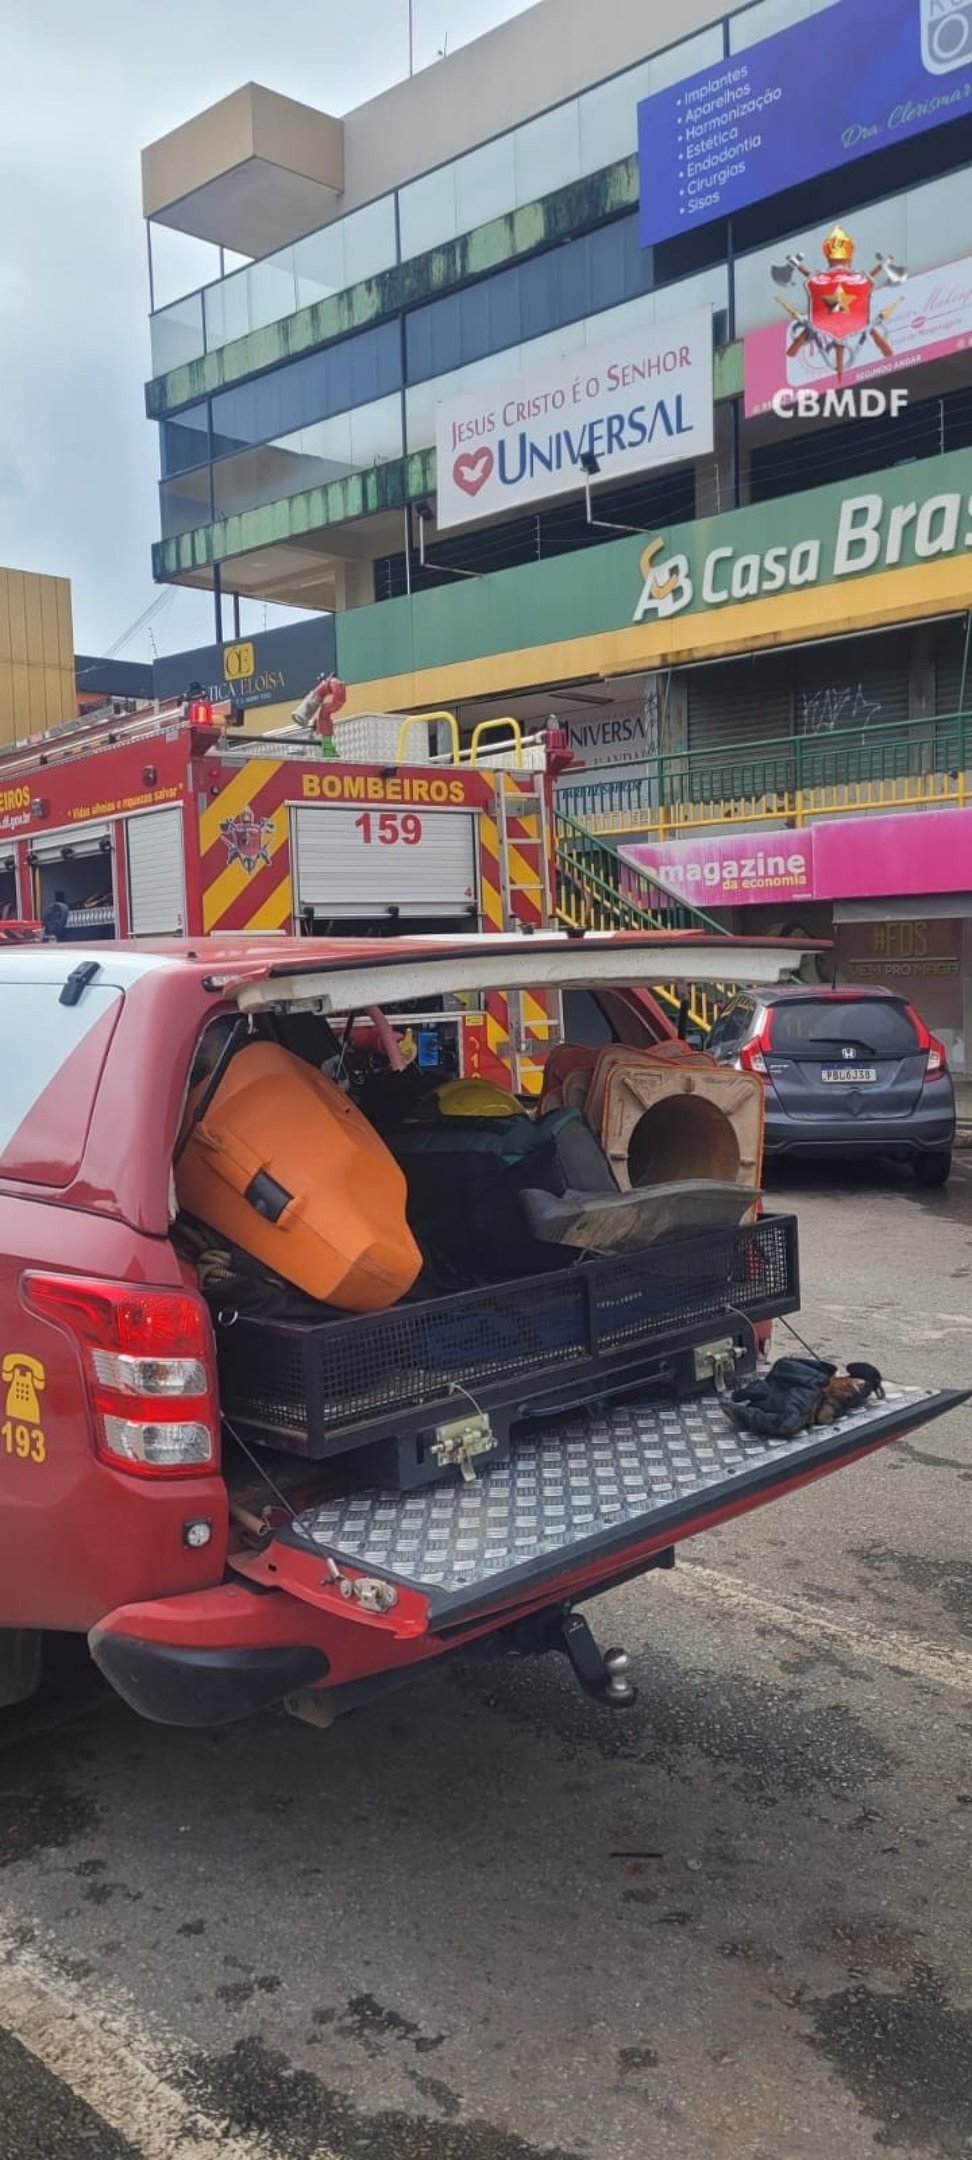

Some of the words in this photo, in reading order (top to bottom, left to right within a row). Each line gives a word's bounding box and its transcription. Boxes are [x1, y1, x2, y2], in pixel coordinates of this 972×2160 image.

[685, 65, 748, 105] Implantes
[685, 83, 751, 124] Aparelhos
[685, 87, 783, 141] Harmonização
[686, 126, 739, 159] Estética
[687, 134, 762, 178] Endodontia
[687, 161, 747, 196] Cirurgias
[687, 191, 721, 214] Sisos
[451, 413, 495, 451] JESUS
[502, 387, 565, 428] CRISTO
[572, 376, 584, 405] É
[585, 379, 600, 399] O
[606, 345, 692, 393] SENHOR
[498, 394, 694, 485] UNIVERSAL
[702, 540, 820, 604] Casa
[834, 493, 972, 577] Bra
[302, 773, 466, 803] BOMBEIROS
[354, 811, 423, 846] 159
[658, 852, 806, 886] magazine
[722, 877, 738, 891] da
[743, 873, 807, 889] economia
[884, 962, 912, 977] PRO
[2, 1421, 46, 1463] 193
